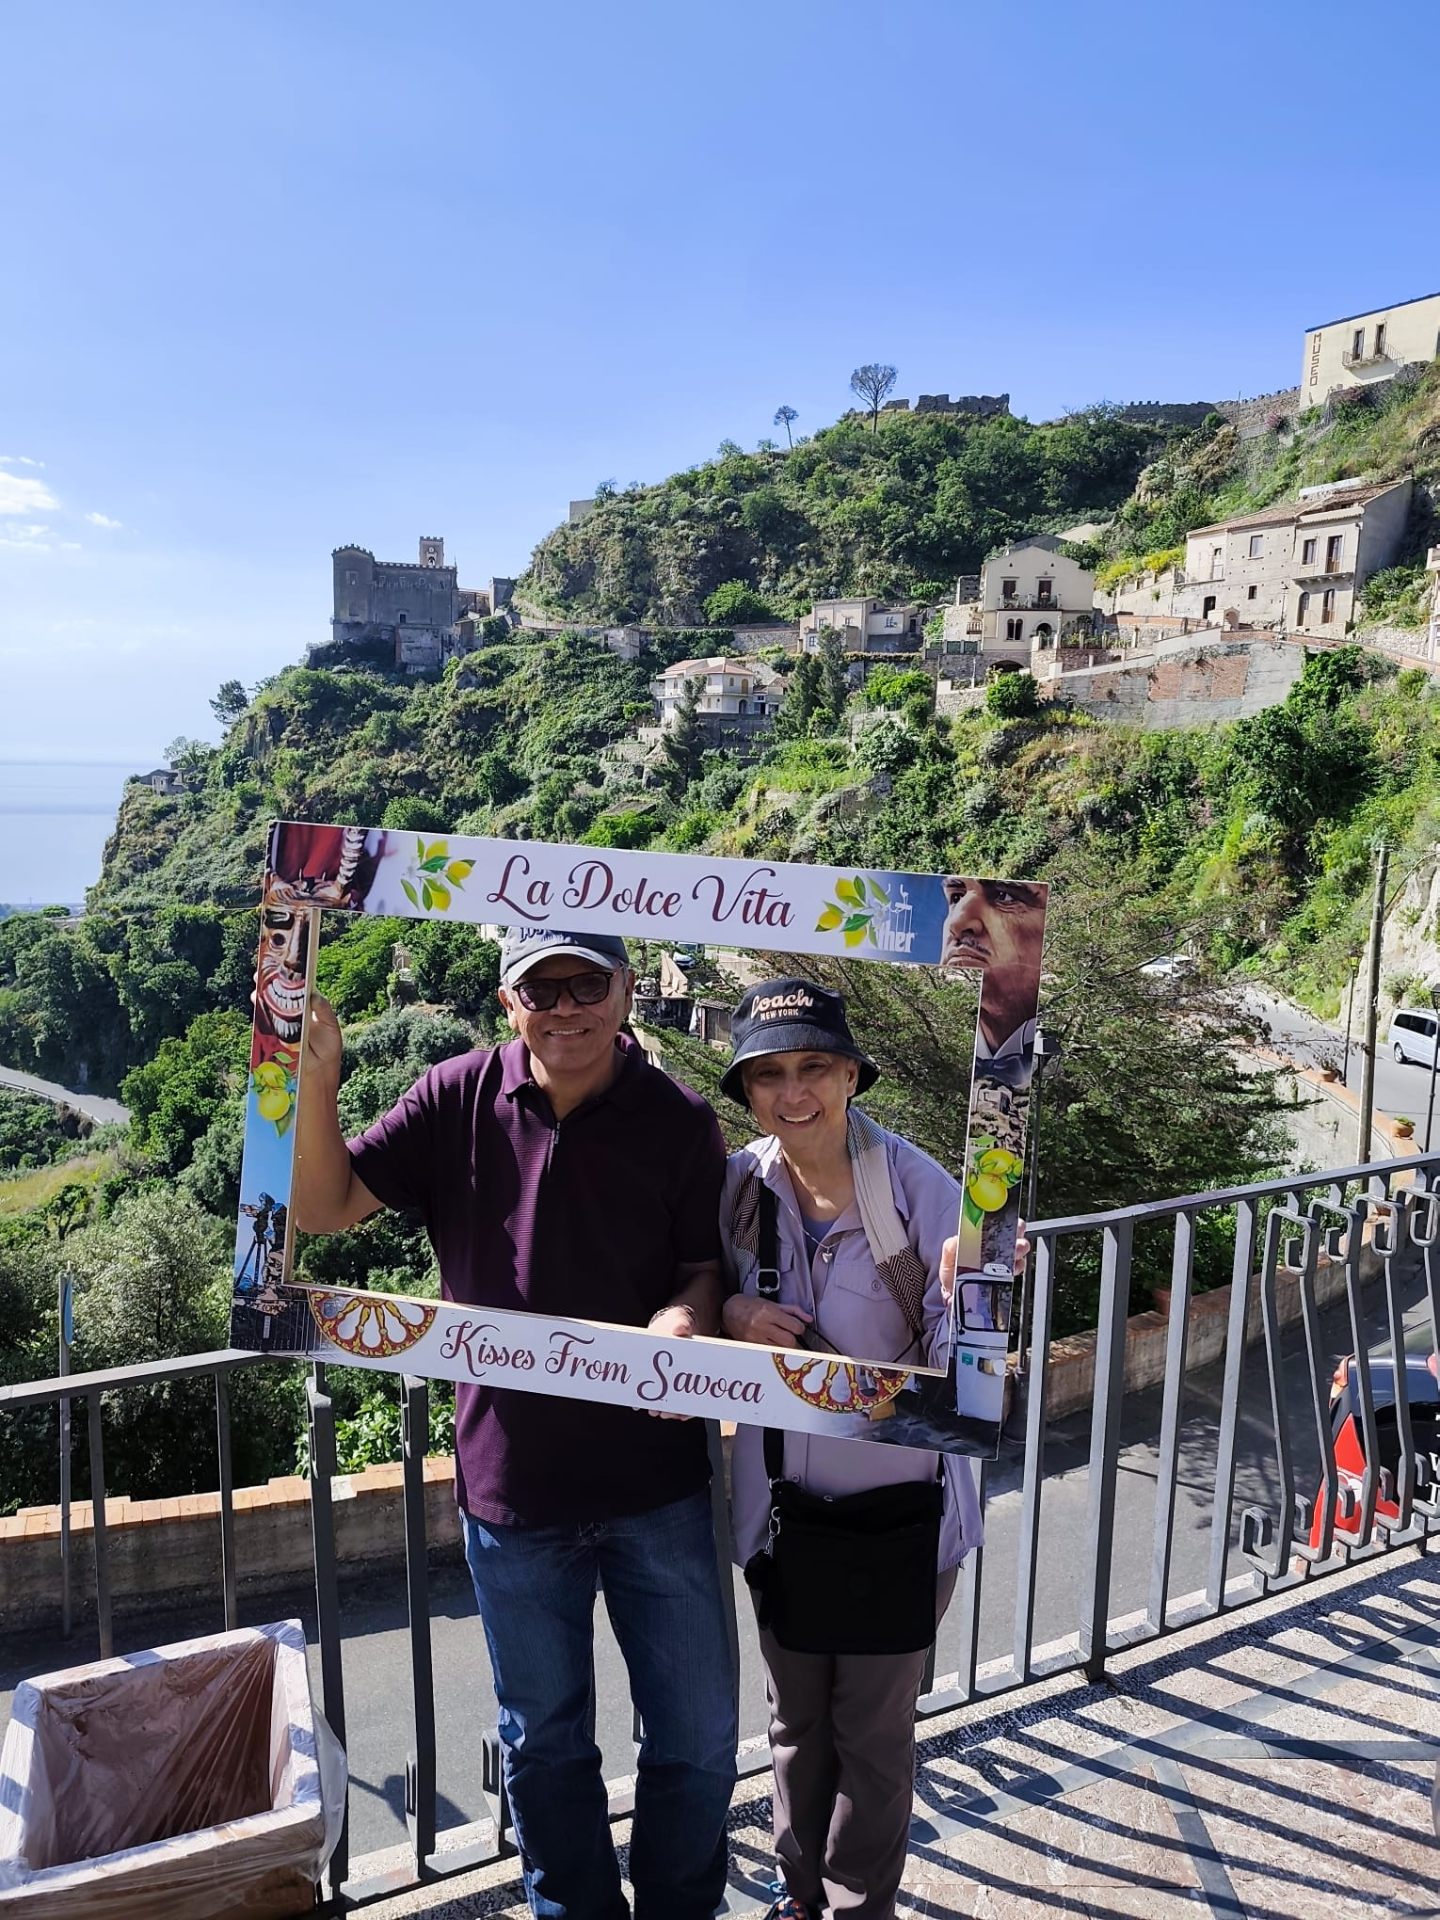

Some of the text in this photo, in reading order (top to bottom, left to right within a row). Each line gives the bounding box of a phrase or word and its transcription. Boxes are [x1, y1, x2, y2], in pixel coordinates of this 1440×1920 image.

[1309, 332, 1322, 387] MUSEO
[487, 855, 796, 928] La Dolce Vita
[750, 988, 814, 1019] Coach
[760, 1008, 799, 1021] NEW YORK
[440, 1320, 765, 1403] Kisses From Savoca
